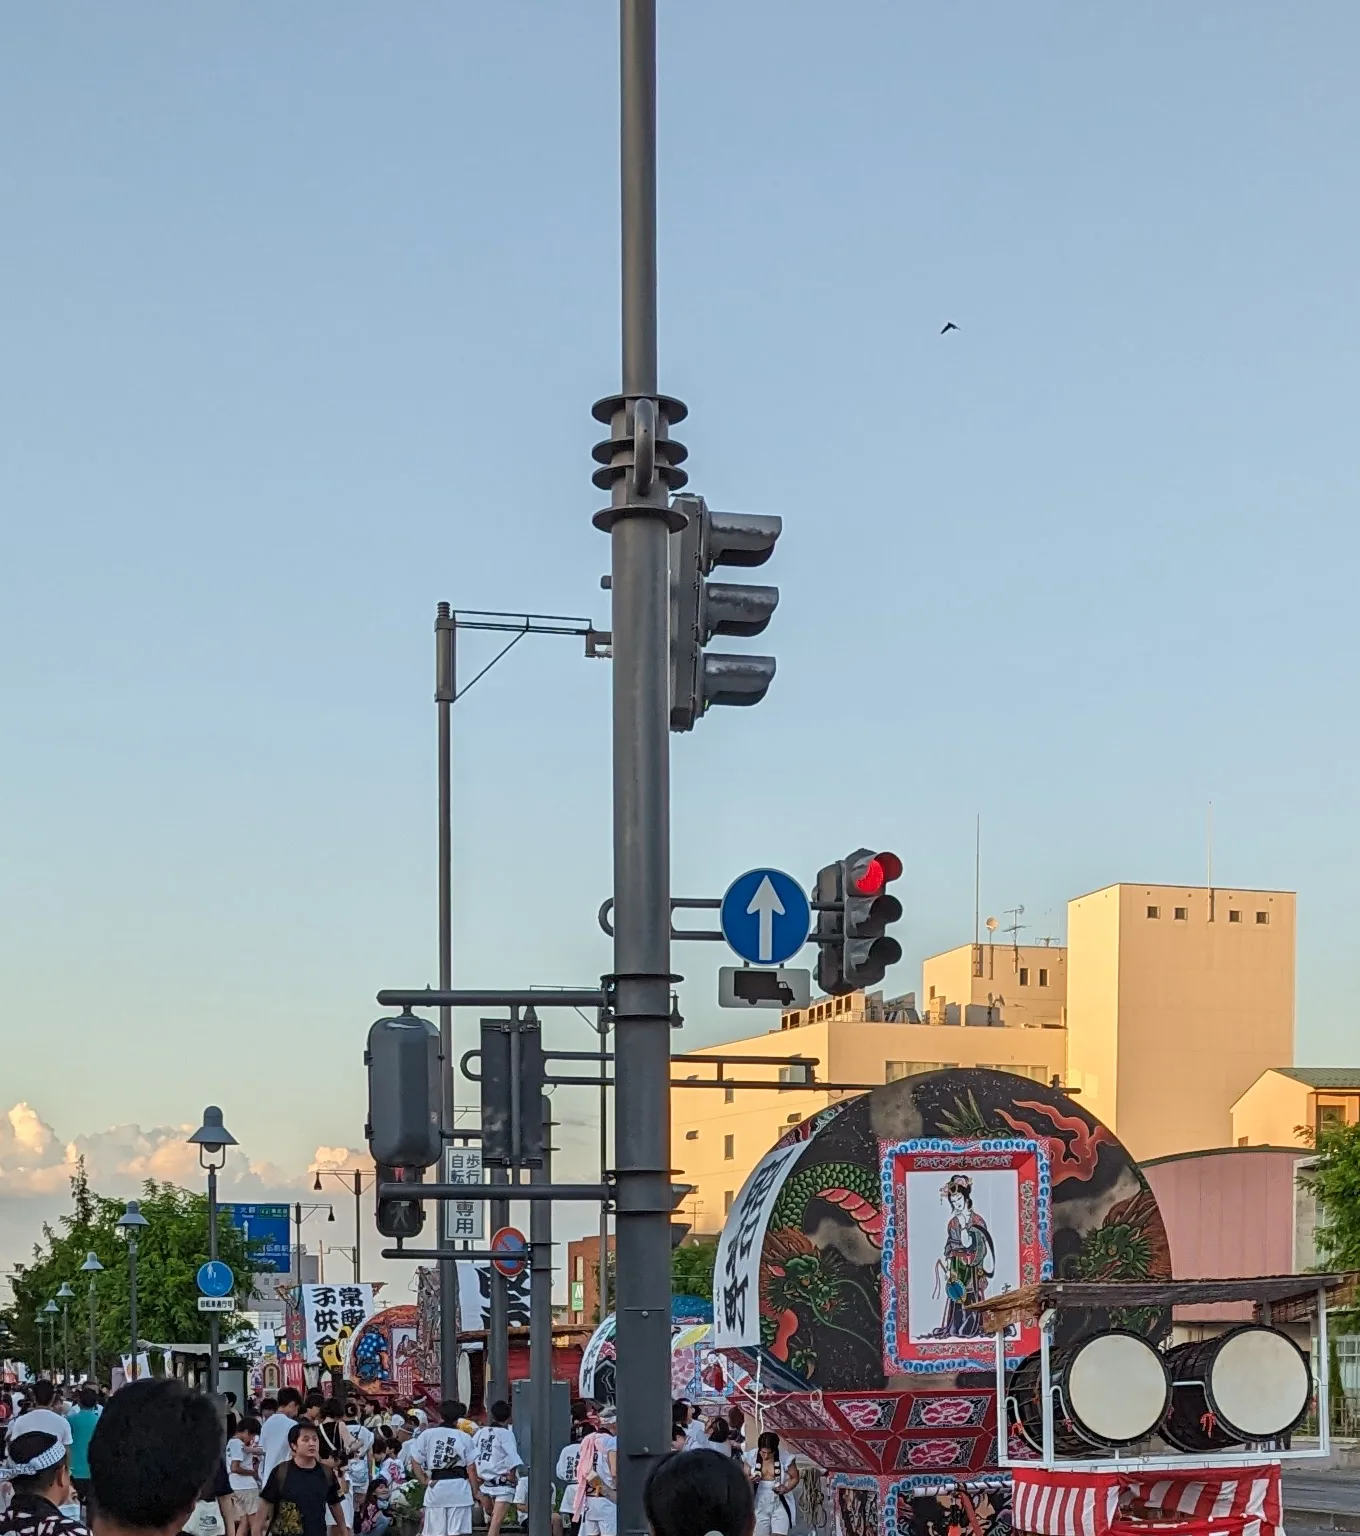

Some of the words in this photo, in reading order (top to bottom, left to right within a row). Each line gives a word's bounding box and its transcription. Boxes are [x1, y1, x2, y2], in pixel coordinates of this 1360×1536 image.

[450, 1153, 465, 1184] 自転
[465, 1153, 481, 1184] 歩行
[454, 1200, 475, 1234] 専用
